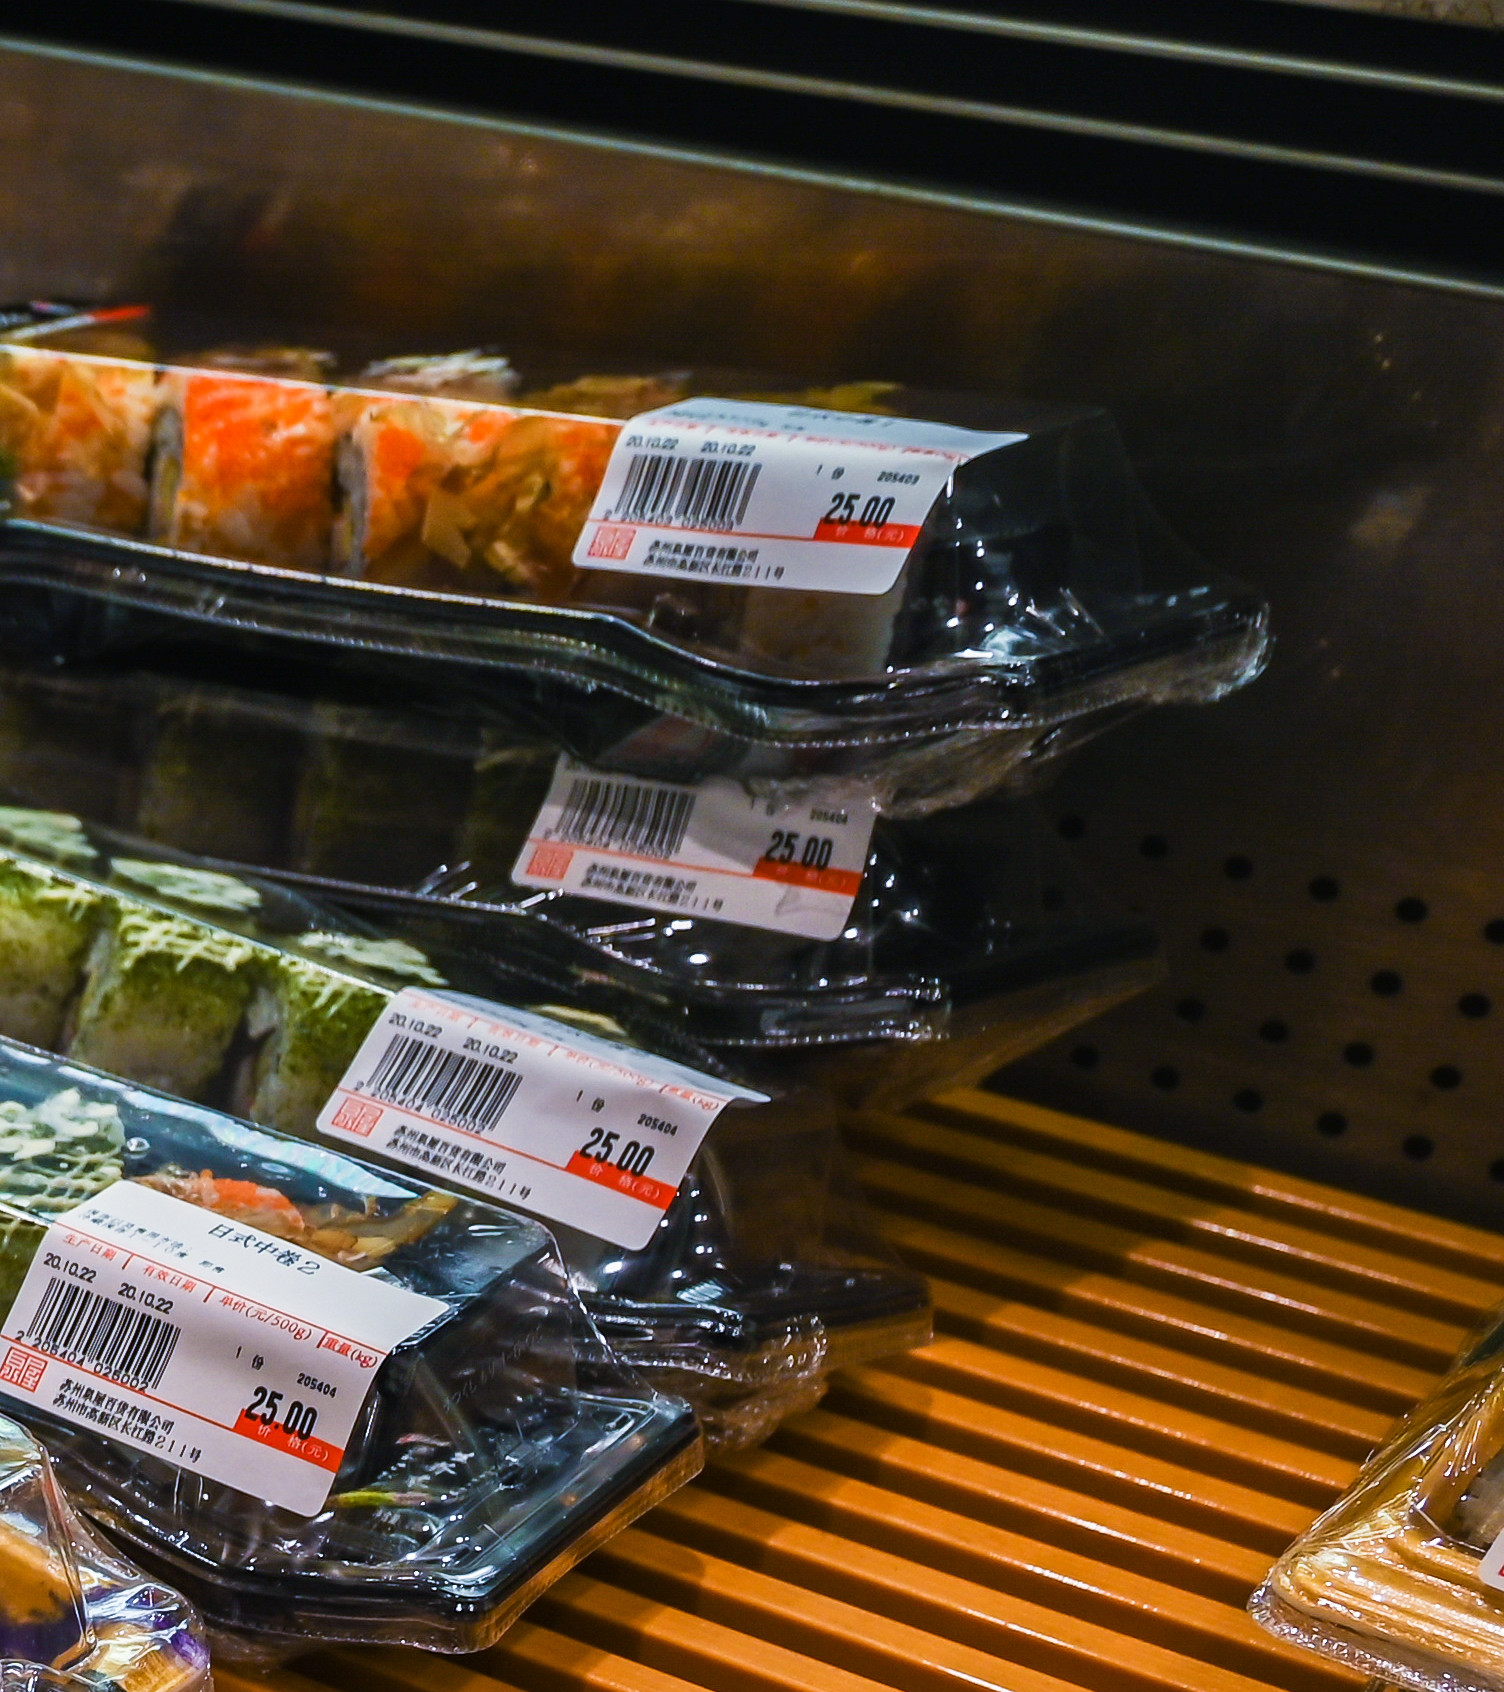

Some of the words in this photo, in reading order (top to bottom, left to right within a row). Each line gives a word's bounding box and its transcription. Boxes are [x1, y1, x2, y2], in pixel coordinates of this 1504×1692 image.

[823, 492, 895, 528] 25.00
[764, 831, 833, 871] 25.00
[388, 1012, 442, 1038] 20.10.22
[463, 1037, 518, 1064] 20.10.22
[637, 1113, 678, 1136] 205404
[580, 1127, 656, 1177] 25.00
[208, 1222, 321, 1276] 日式中卷2
[43, 1252, 97, 1283] 20.10.22
[118, 1283, 175, 1314] 20.10.22
[62, 1233, 116, 1262] 生产日期
[142, 1264, 197, 1292] 有效日期
[220, 1293, 313, 1341] 单价(元/500g)
[322, 1333, 379, 1369] 重量(kg)
[33, 1336, 84, 1367] 205404
[94, 1362, 149, 1393] 025002
[235, 1345, 242, 1358] 1
[250, 1355, 264, 1369] 份
[297, 1372, 337, 1398] 205404
[244, 1386, 317, 1440] 25.00
